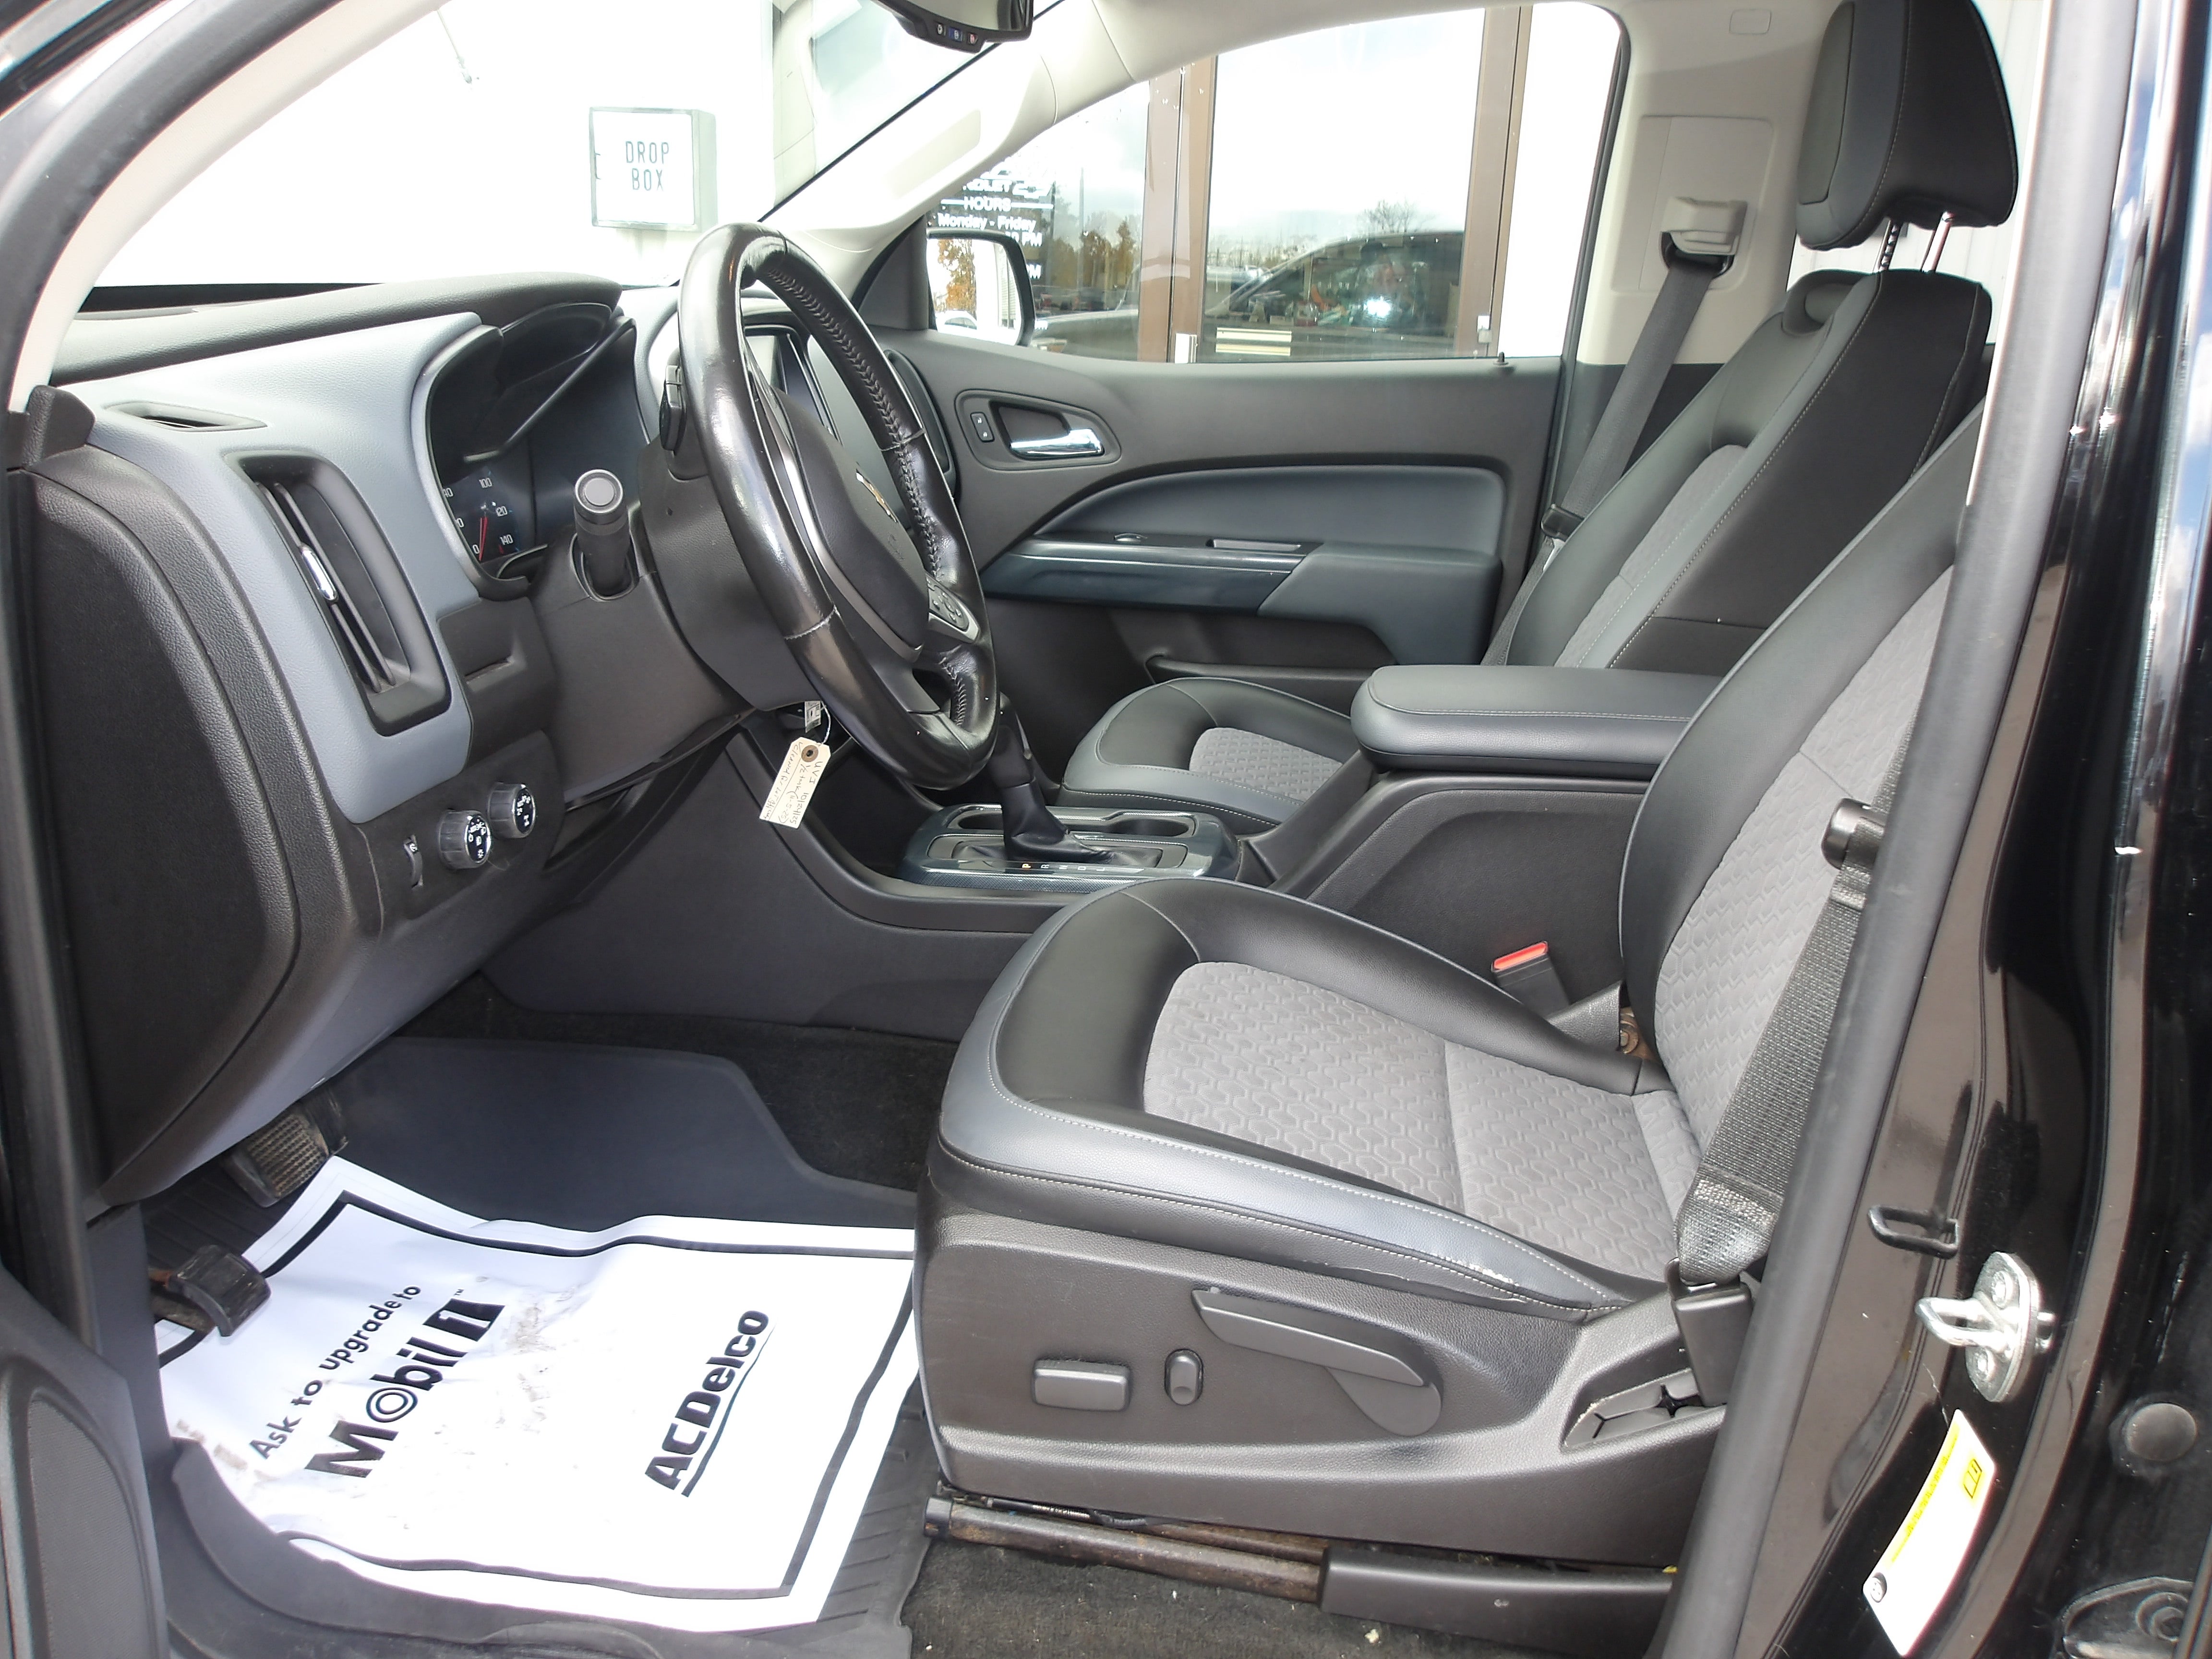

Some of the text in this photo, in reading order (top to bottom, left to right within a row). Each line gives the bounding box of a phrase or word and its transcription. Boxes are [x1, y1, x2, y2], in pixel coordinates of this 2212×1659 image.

[625, 141, 669, 165] DROP
[632, 168, 664, 192] BOX
[963, 196, 1011, 212] HOURS
[938, 213, 988, 230] Monday
[997, 215, 1036, 233] Friday
[1022, 231, 1042, 247] PM
[479, 478, 493, 489] 100
[495, 505, 508, 517] 120
[500, 534, 514, 545] 140
[249, 1285, 421, 1460] Ask to upgrade to
[303, 1336, 469, 1479] Mobil
[644, 1310, 769, 1491] ACDelco
